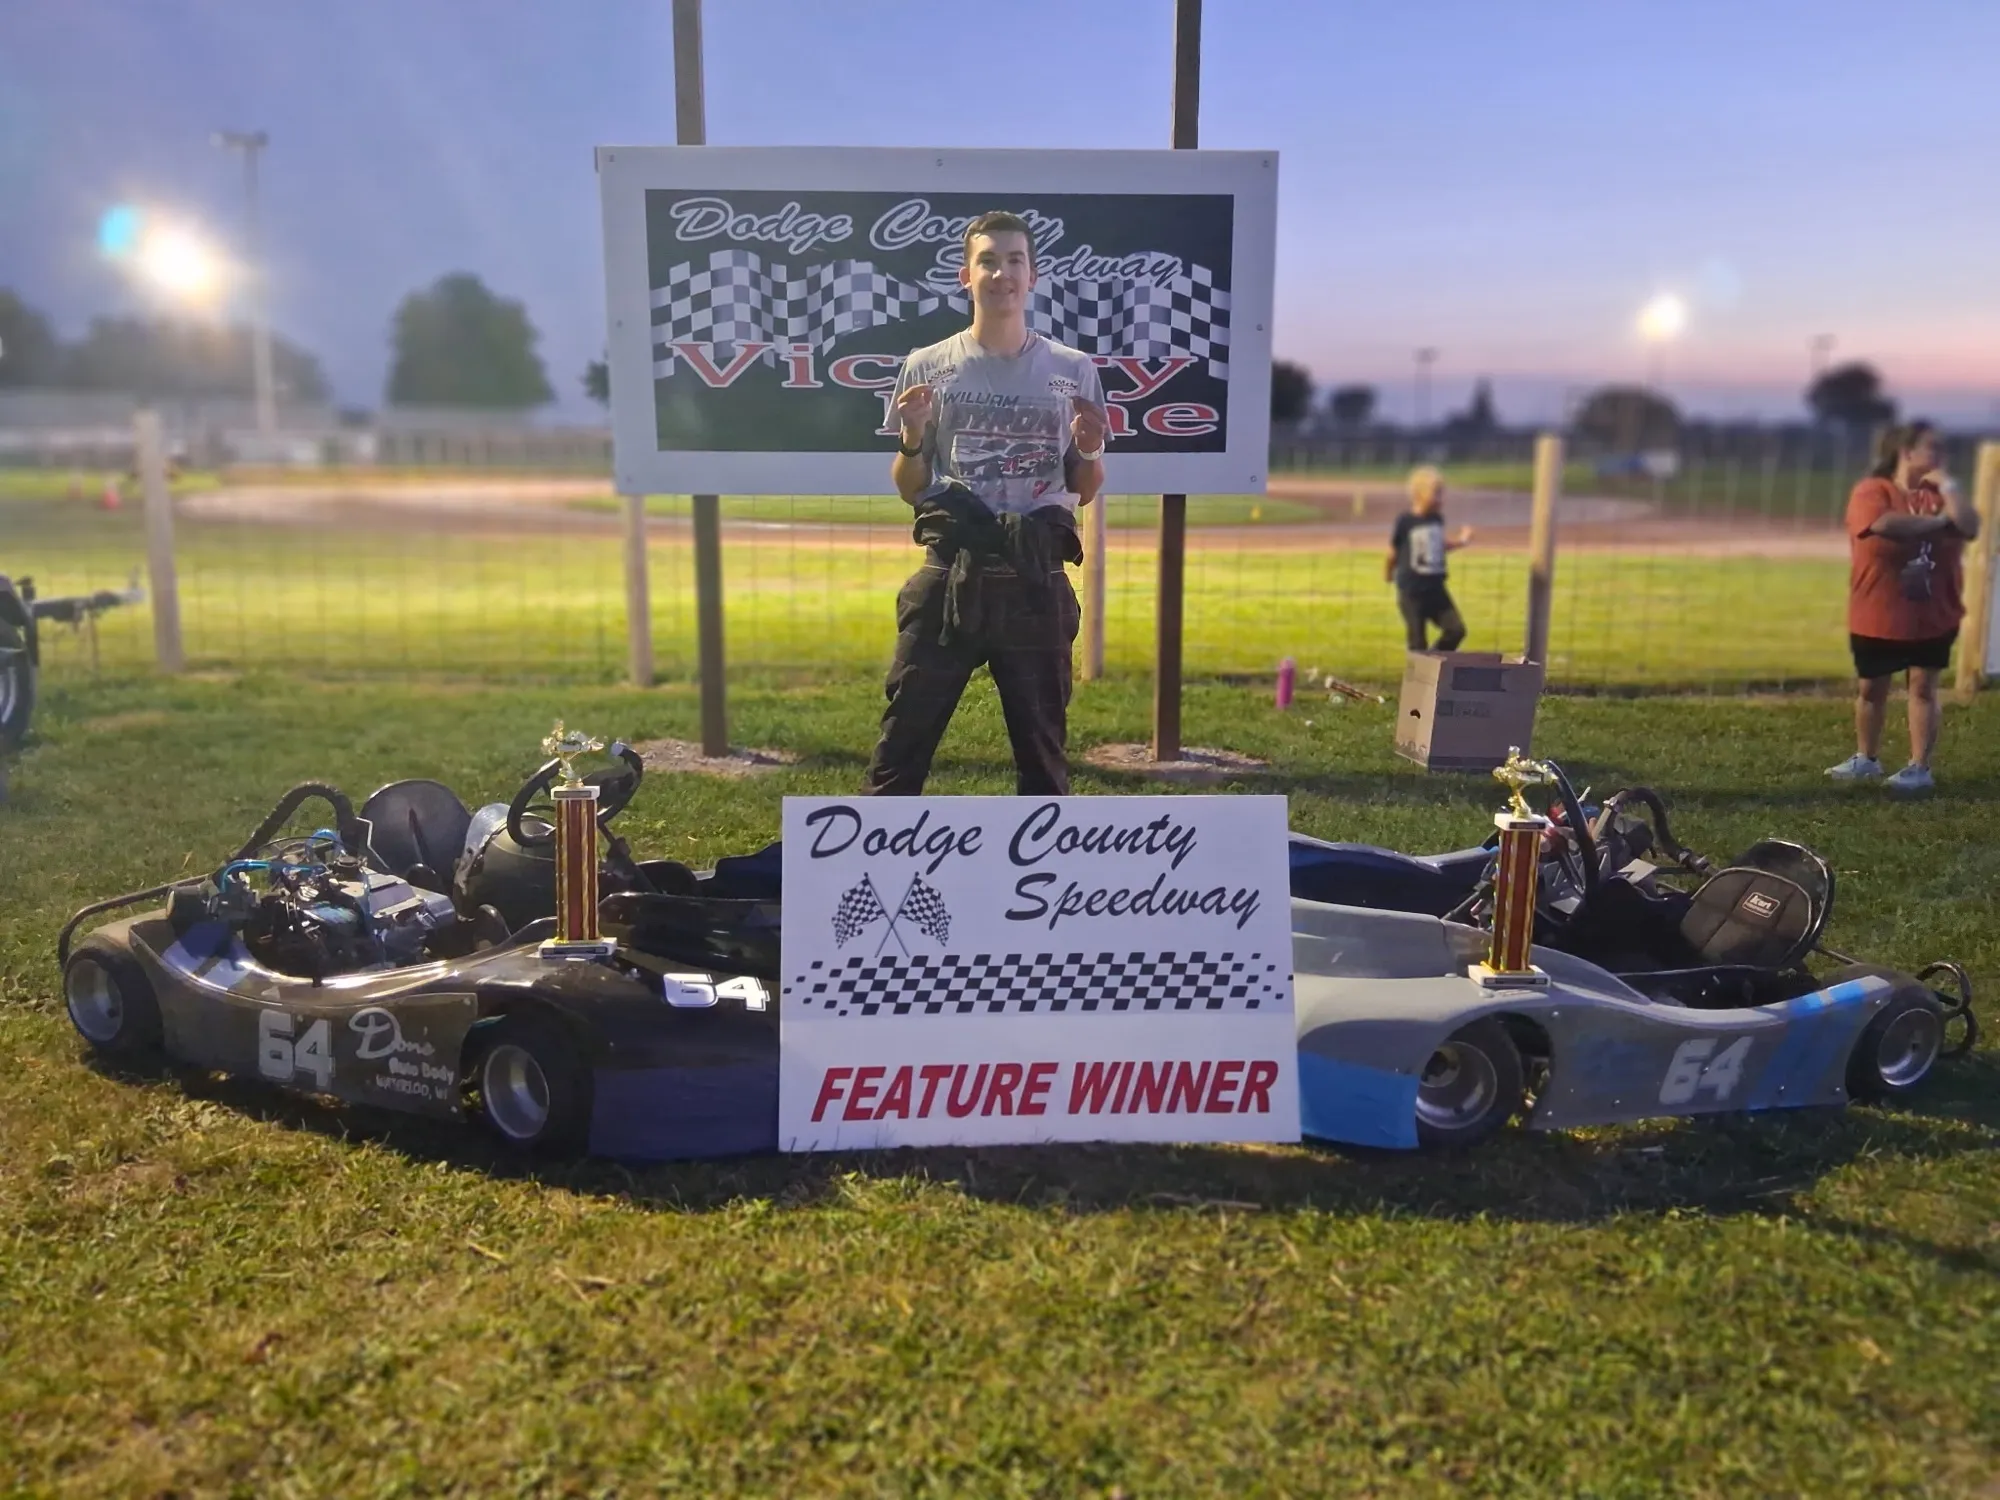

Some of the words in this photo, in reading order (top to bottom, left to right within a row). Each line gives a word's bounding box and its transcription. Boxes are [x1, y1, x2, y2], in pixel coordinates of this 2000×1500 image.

[670, 197, 853, 255] Dodge
[869, 198, 1065, 257] Couy
[925, 244, 1182, 289] Sedway
[665, 341, 1199, 401] Vicy
[943, 391, 1020, 408] WILLIAM
[805, 804, 983, 875] Dodge
[1007, 802, 1198, 869] County
[1004, 872, 1261, 930] Speedway
[662, 973, 771, 1012] 64
[258, 1008, 336, 1089] 64
[421, 1061, 455, 1086] Body
[1658, 1035, 1755, 1105] 64
[810, 1061, 1060, 1124] FEATURE
[1067, 1059, 1280, 1116] WINNER
